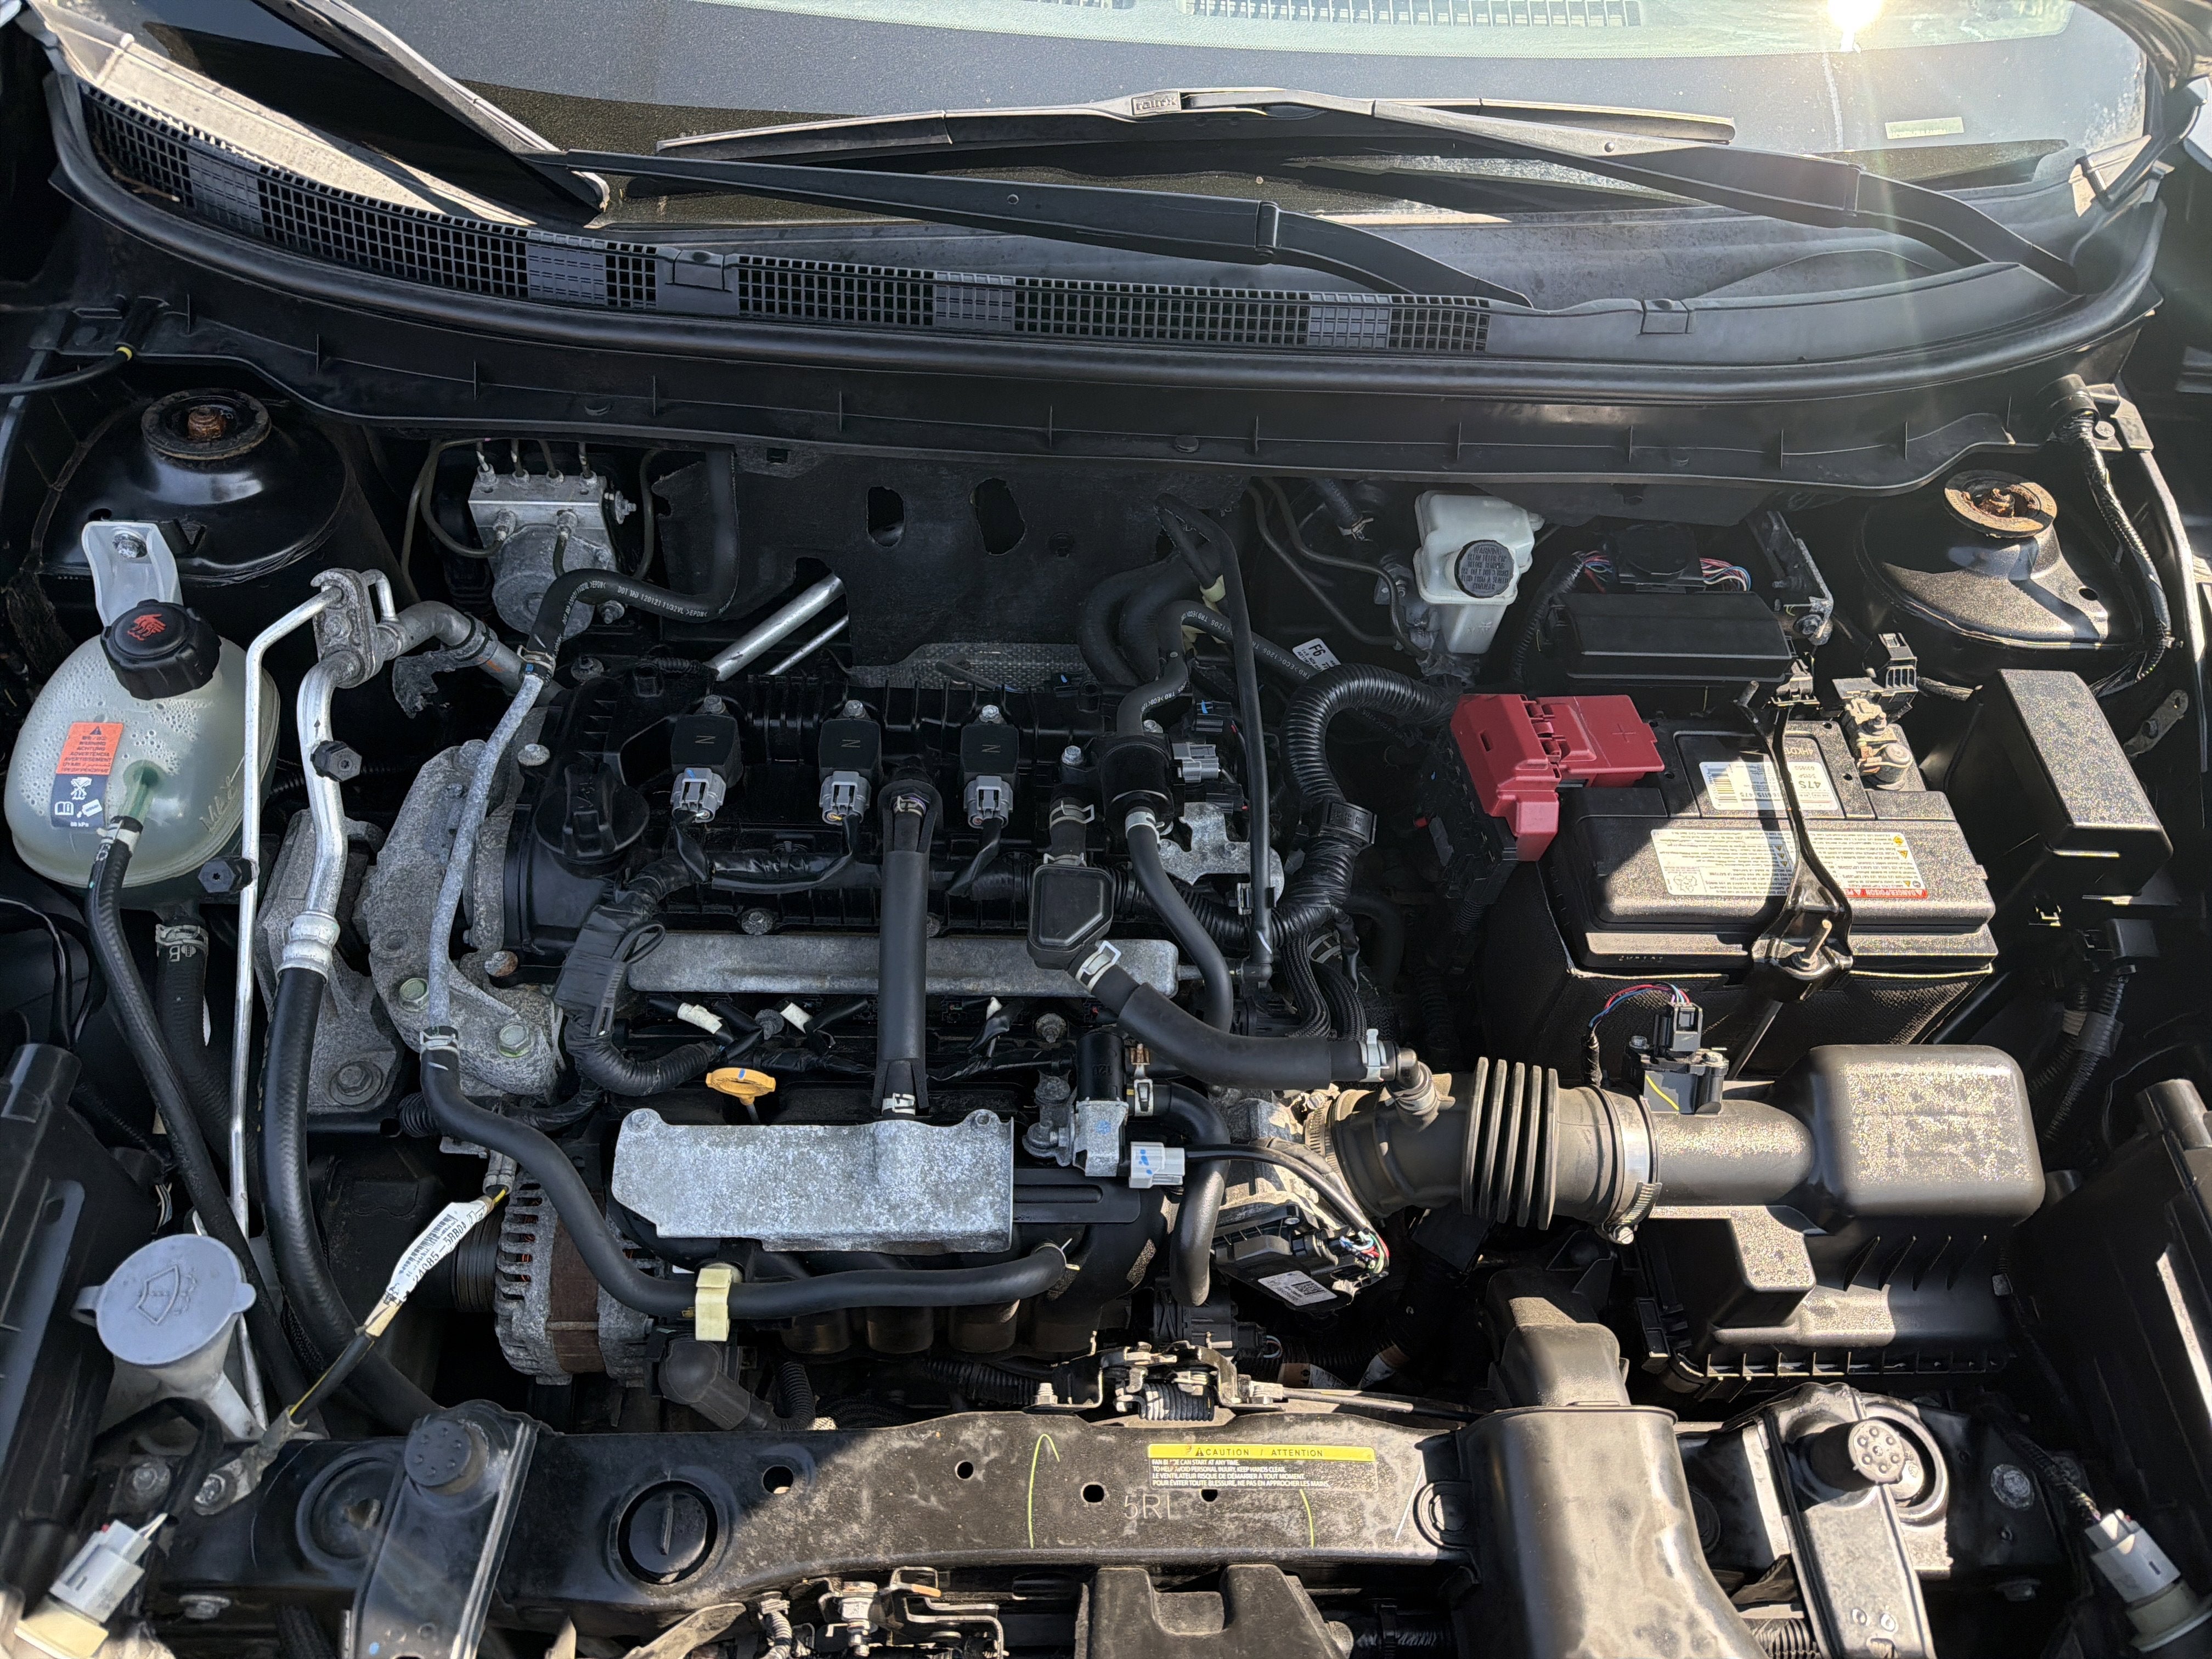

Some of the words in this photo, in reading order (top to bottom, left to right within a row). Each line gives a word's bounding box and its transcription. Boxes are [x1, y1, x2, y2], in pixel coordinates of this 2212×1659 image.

[617, 585, 628, 595] DOT
[1308, 644, 1326, 657] F6
[1271, 1449, 1323, 1457] ATTENTION
